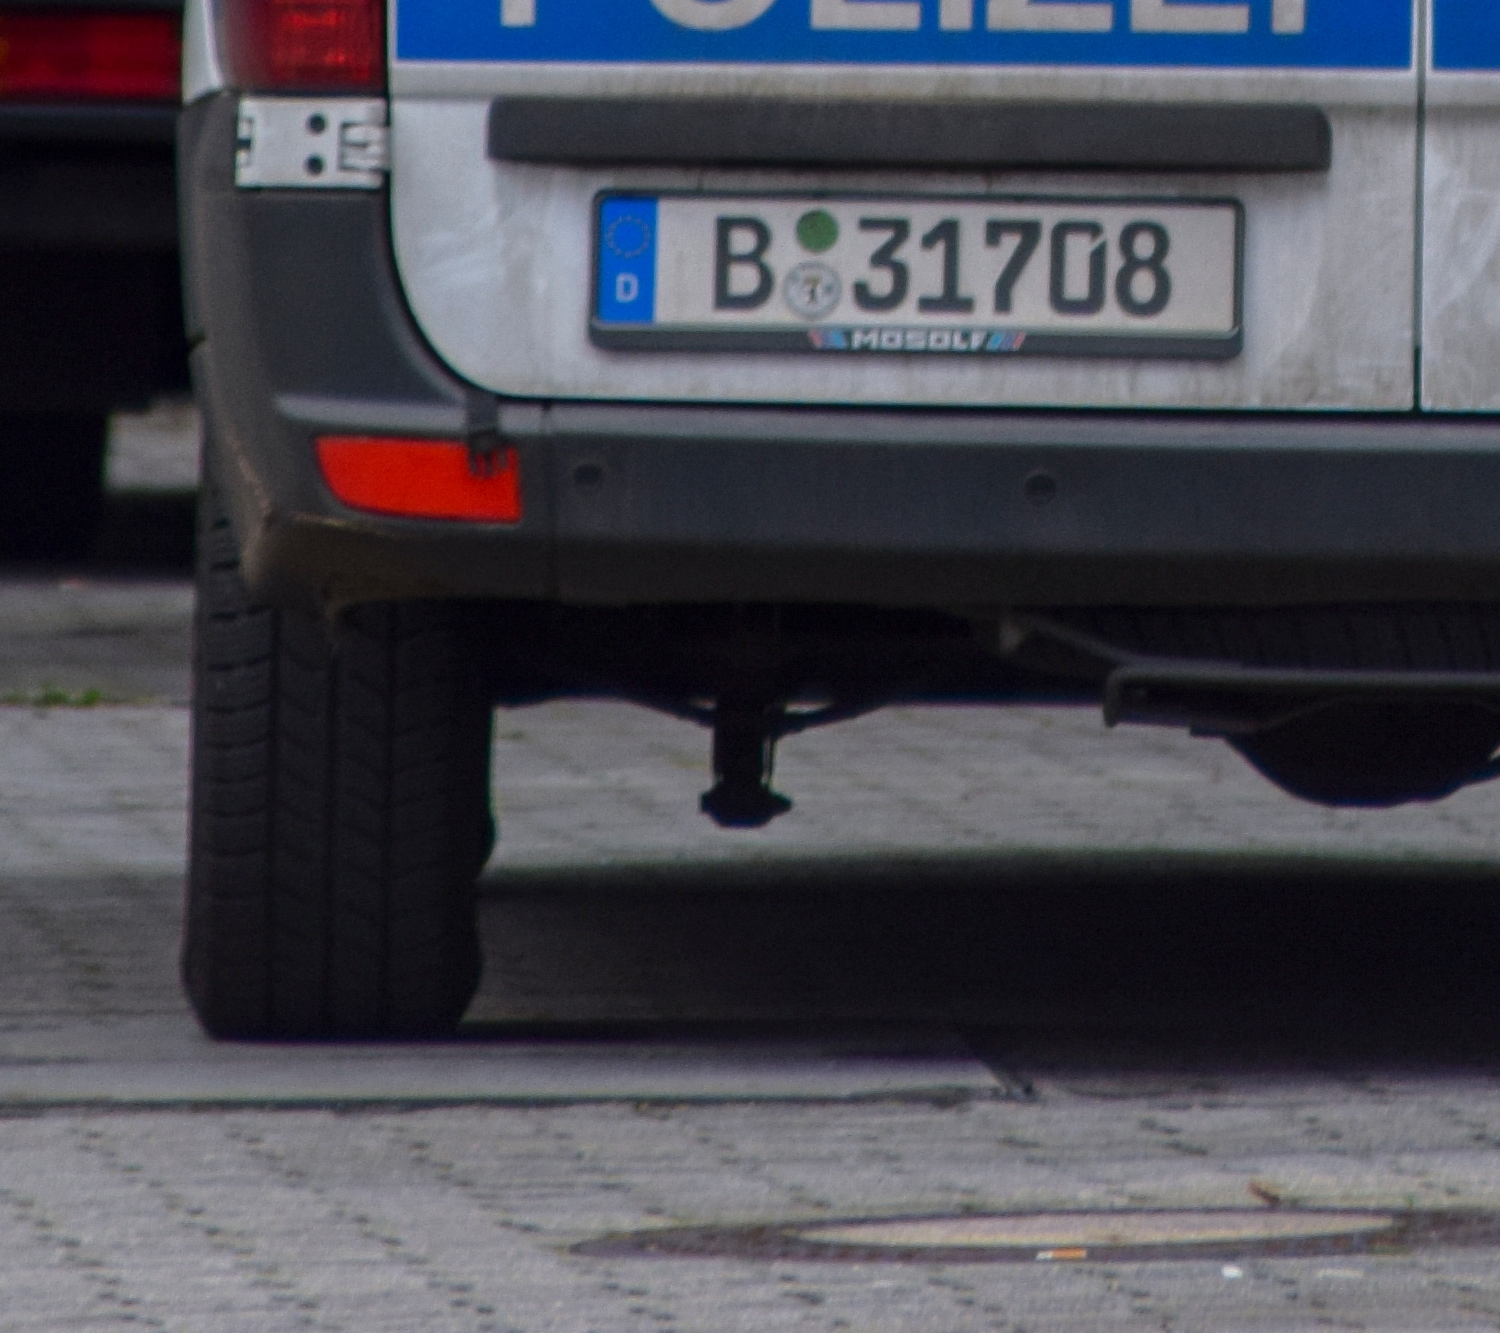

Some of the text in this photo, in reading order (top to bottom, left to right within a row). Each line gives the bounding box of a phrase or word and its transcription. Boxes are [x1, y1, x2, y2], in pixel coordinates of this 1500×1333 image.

[615, 274, 638, 302] D
[714, 216, 1171, 316] B 31708
